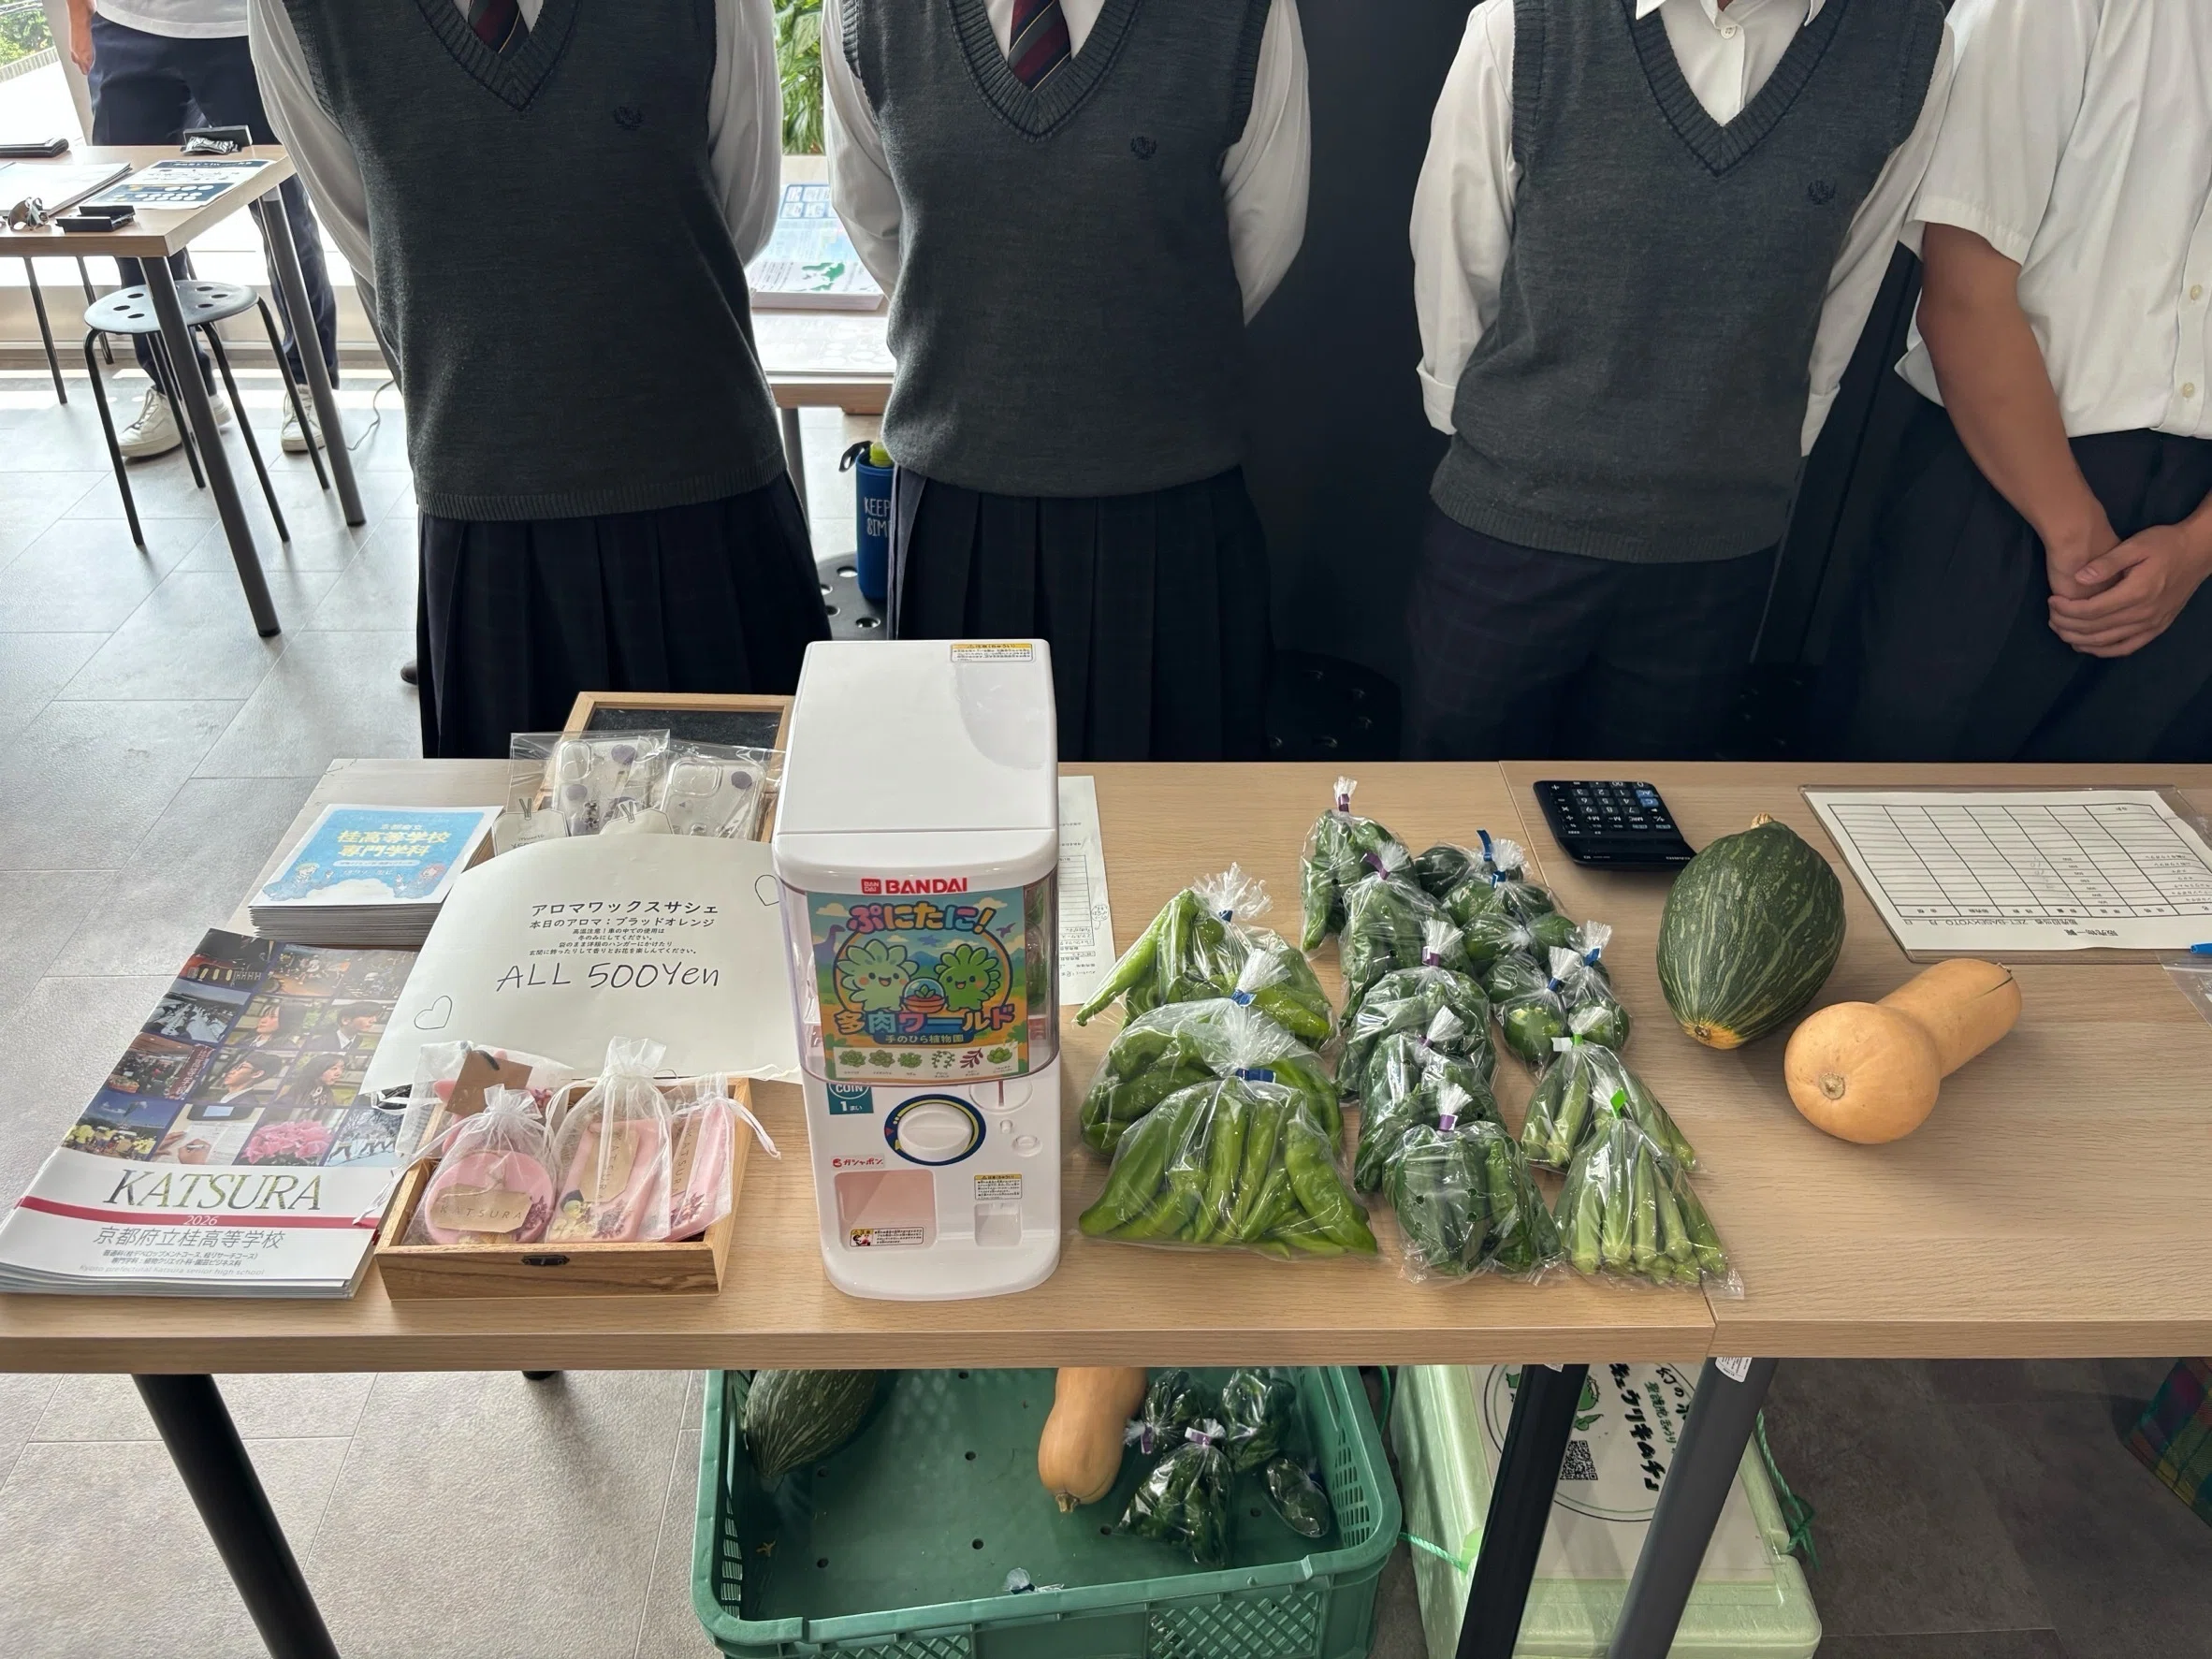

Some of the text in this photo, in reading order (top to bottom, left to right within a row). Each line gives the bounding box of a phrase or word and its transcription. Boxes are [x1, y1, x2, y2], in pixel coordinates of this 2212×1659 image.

[864, 497, 891, 517] KEEP
[866, 517, 892, 537] SIM
[338, 830, 452, 844] 桂高等学校
[339, 844, 431, 858] 専門学科
[885, 878, 968, 895] BANDAI
[531, 900, 719, 917] アロマワックスサシェ
[529, 916, 715, 929] 本日のアロマ：ブラッドオレンジ
[847, 901, 997, 934] ぷにたに！
[496, 961, 720, 992] ALL 500Yen
[834, 1004, 1015, 1035] 多肉ワールド
[885, 1034, 965, 1043] 手のひら植物園
[835, 1082, 864, 1093] COIN
[103, 1169, 322, 1211] KATSURA
[183, 1215, 219, 1226] 2026
[440, 1205, 521, 1219] KATSURA
[93, 1227, 286, 1249] 京都府立桂高等学校
[215, 1268, 234, 1276] high
